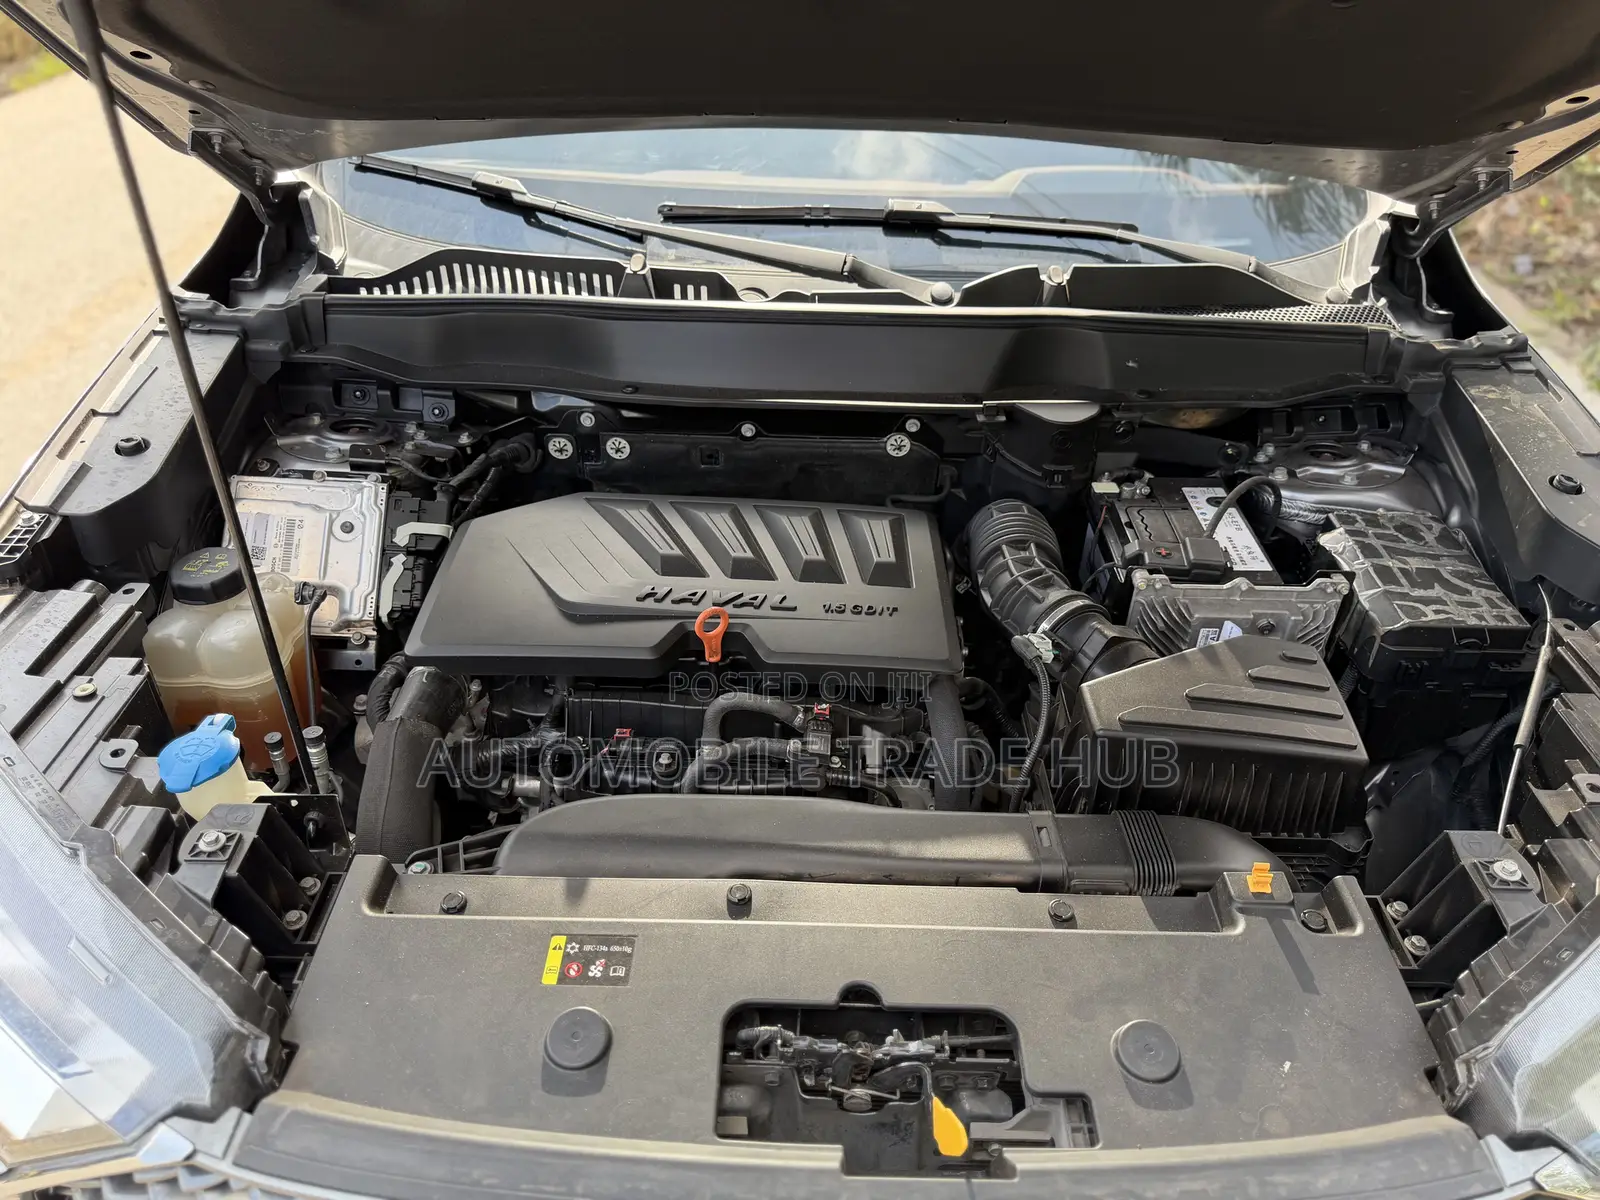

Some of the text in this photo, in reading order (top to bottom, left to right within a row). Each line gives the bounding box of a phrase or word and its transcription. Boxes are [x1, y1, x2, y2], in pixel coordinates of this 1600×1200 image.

[636, 585, 798, 611] HAVAL
[822, 601, 899, 617] 1.5 GDIT
